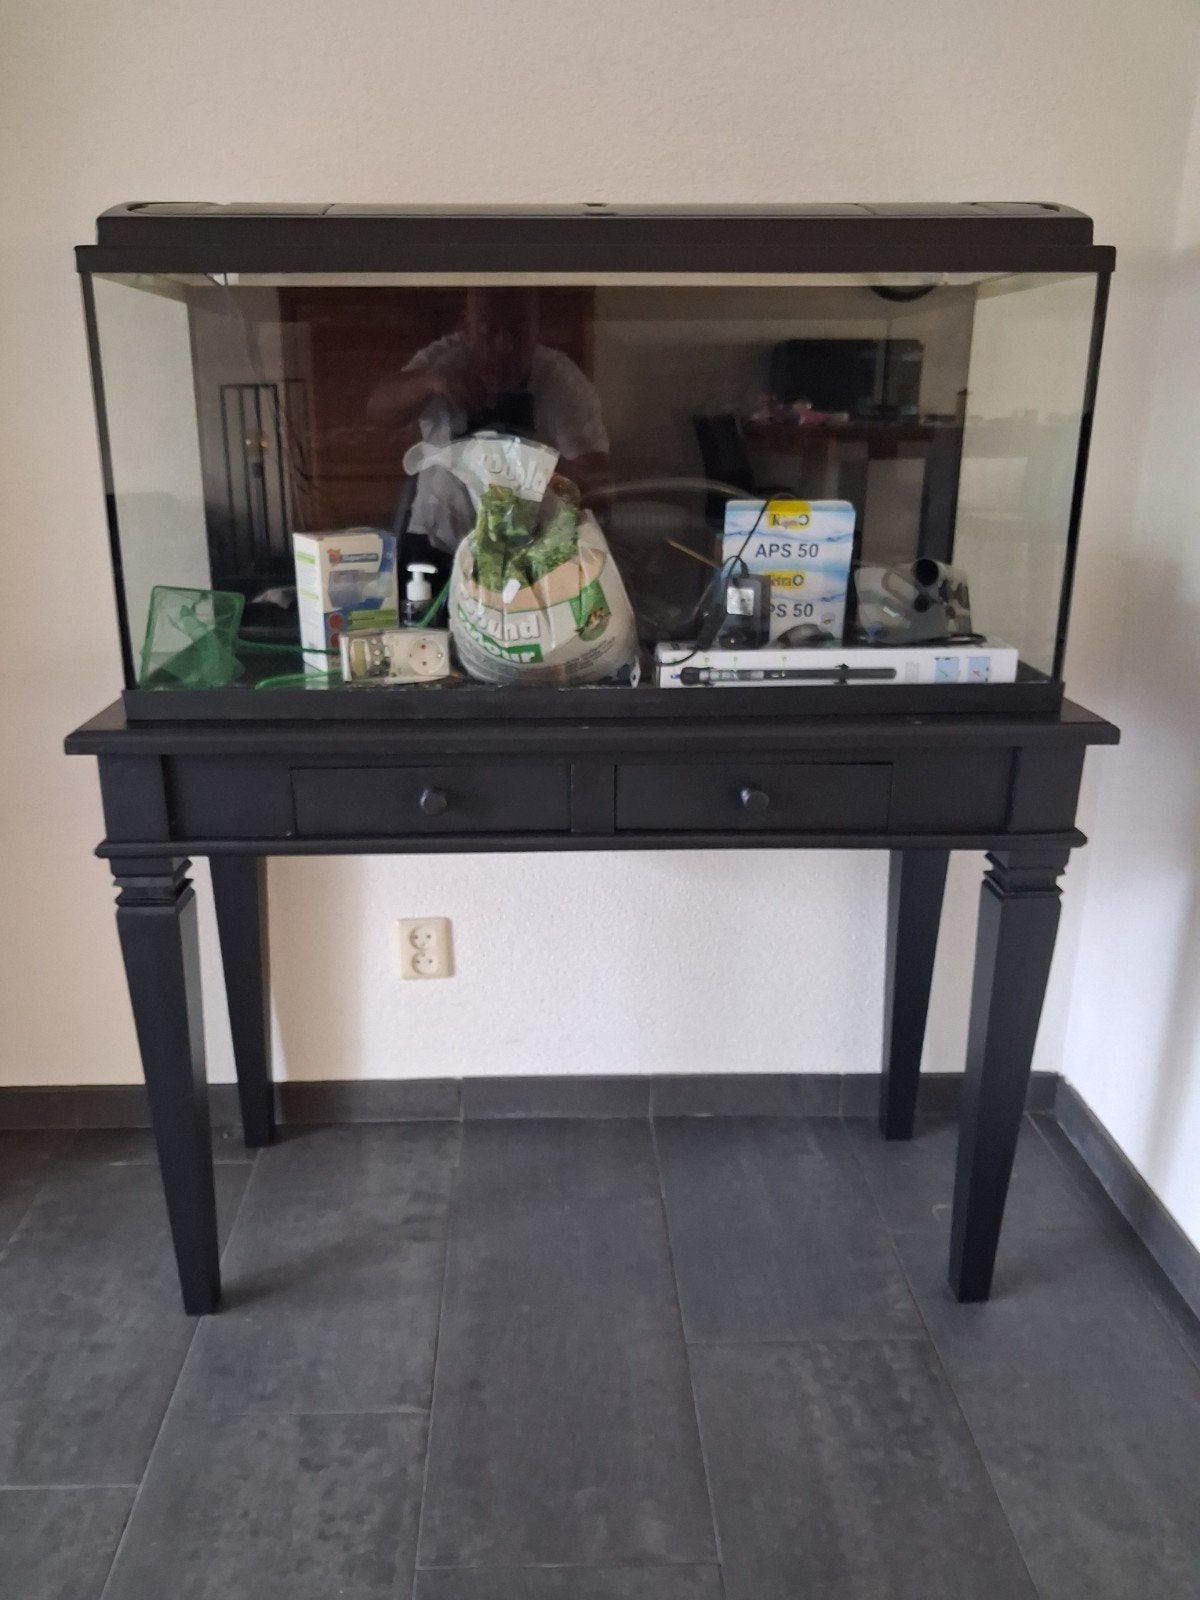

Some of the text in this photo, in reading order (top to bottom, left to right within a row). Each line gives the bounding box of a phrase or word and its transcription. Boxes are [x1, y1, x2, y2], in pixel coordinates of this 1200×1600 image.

[755, 543, 819, 558] APS 50
[793, 603, 814, 618] 50
